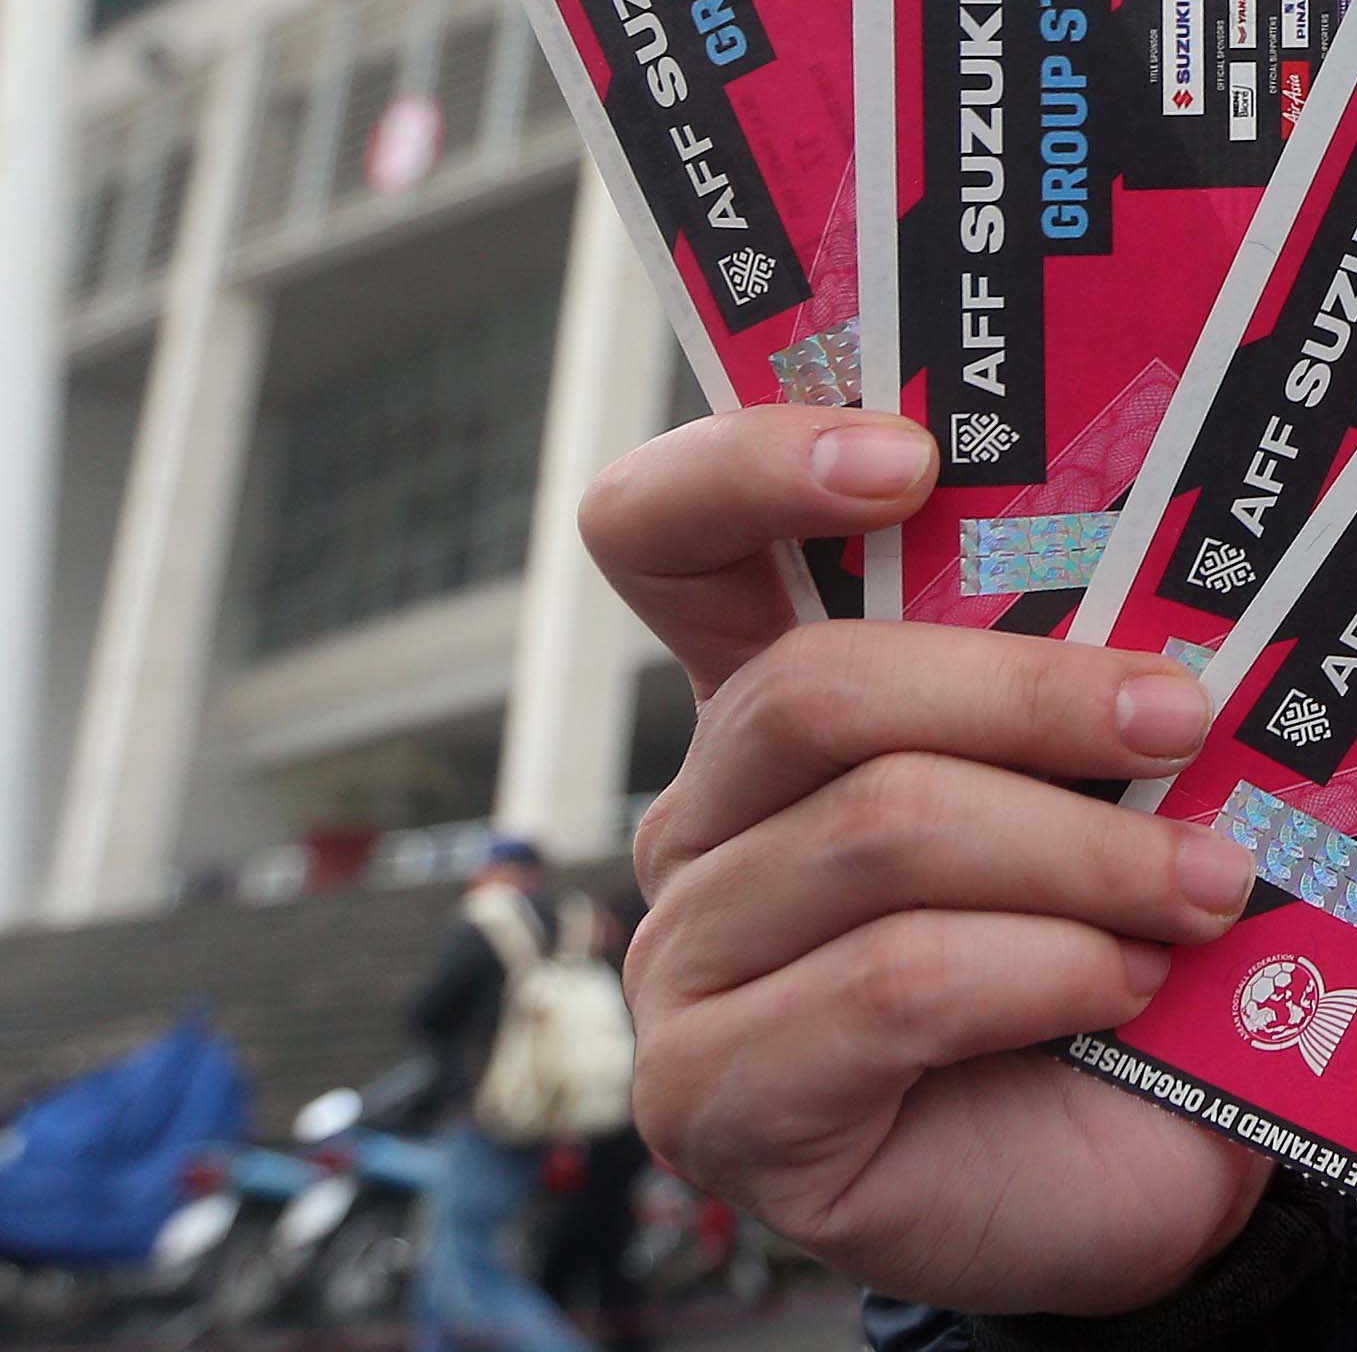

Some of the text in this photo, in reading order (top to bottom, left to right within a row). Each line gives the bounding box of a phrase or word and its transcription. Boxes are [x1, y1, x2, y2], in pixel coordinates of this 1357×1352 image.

[1150, 63, 1159, 83] TITLE
[1176, 1, 1191, 84] SUZUKI
[669, 124, 749, 229] AFF
[1041, 55, 1089, 240] GROUP
[961, 272, 1005, 397] AFF
[1229, 415, 1299, 538] AFF
[1069, 1032, 1206, 1113] ORGANISER
[1201, 1098, 1239, 1129] BY
[1237, 1113, 1348, 1179] RETAINED
